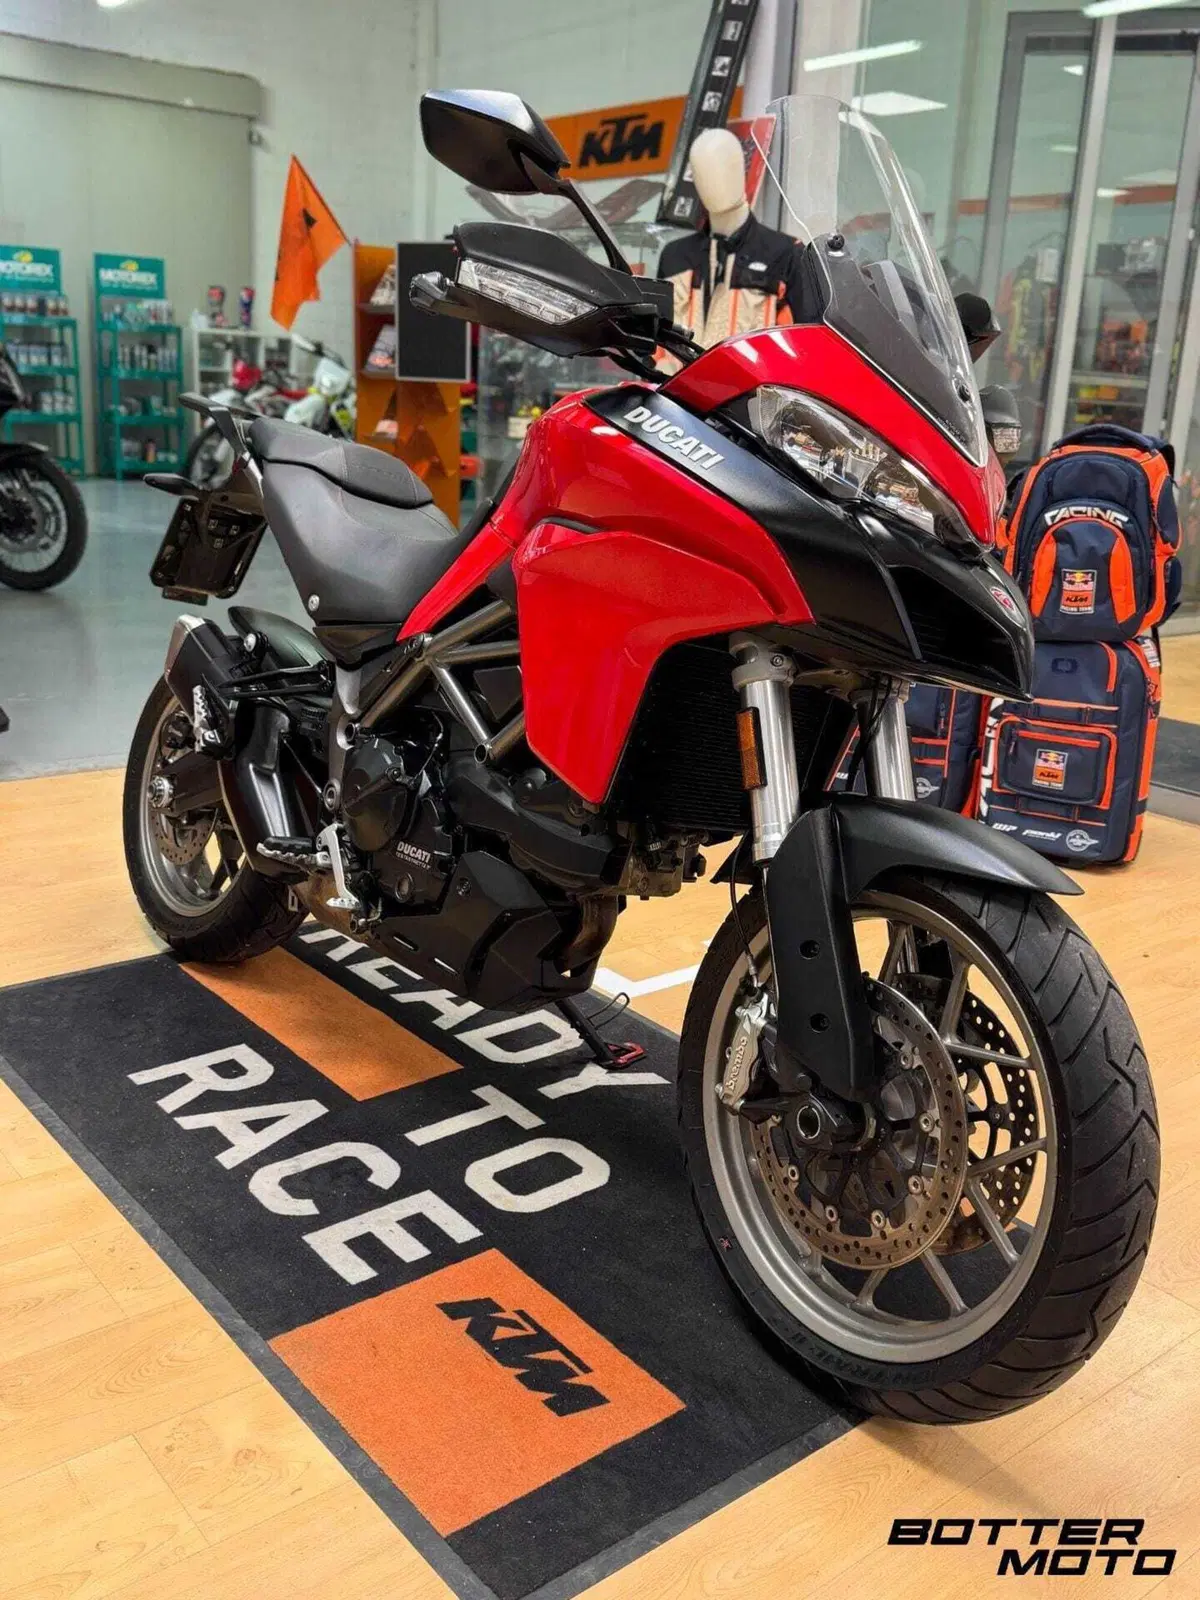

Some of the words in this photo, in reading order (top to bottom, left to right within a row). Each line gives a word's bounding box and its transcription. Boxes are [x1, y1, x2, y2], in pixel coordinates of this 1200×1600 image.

[579, 114, 665, 169] KTM
[0, 259, 54, 278] OTOREX
[623, 405, 725, 471] DUCATI
[396, 841, 431, 864] DUCATI
[725, 1036, 748, 1091] brembo
[127, 1043, 484, 1286] RACE
[404, 1084, 611, 1213] TO
[436, 1297, 611, 1418] KTM
